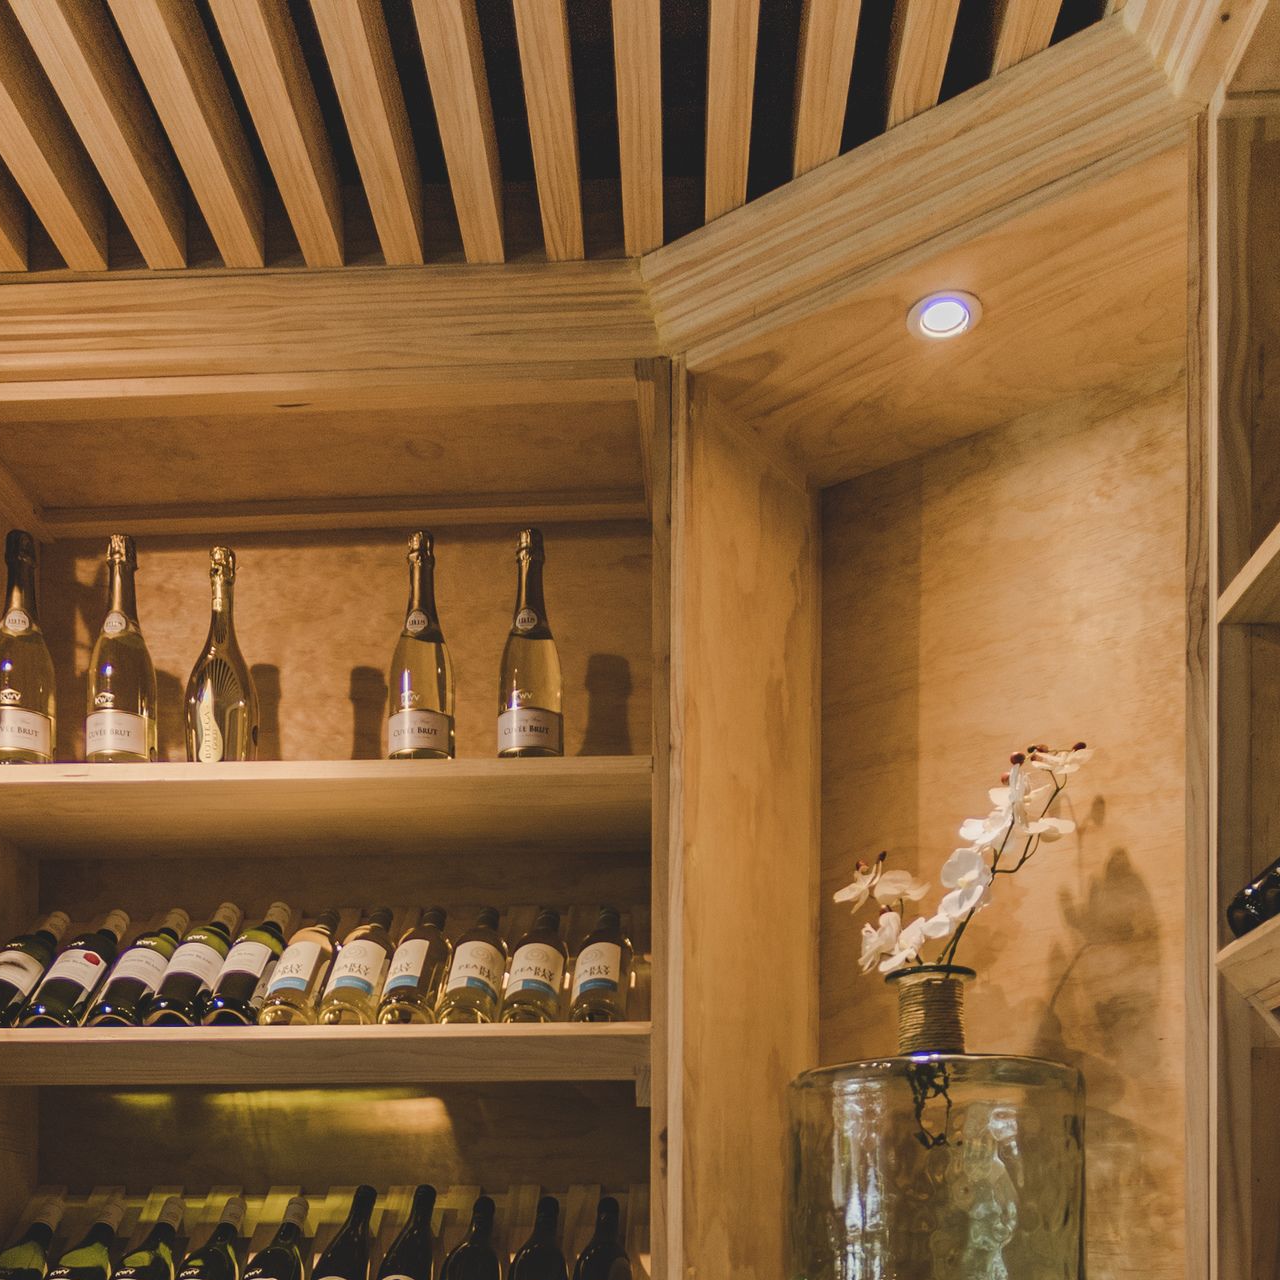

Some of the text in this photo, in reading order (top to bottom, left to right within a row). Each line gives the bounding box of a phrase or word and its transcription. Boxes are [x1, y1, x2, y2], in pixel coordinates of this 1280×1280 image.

[17, 725, 40, 738] BRUT
[108, 728, 132, 738] BRUT
[417, 725, 439, 736] BRUT
[529, 724, 551, 735] BRUT
[49, 1268, 71, 1277] KWV
[114, 1268, 136, 1278] KWV
[179, 1268, 200, 1278] KWV
